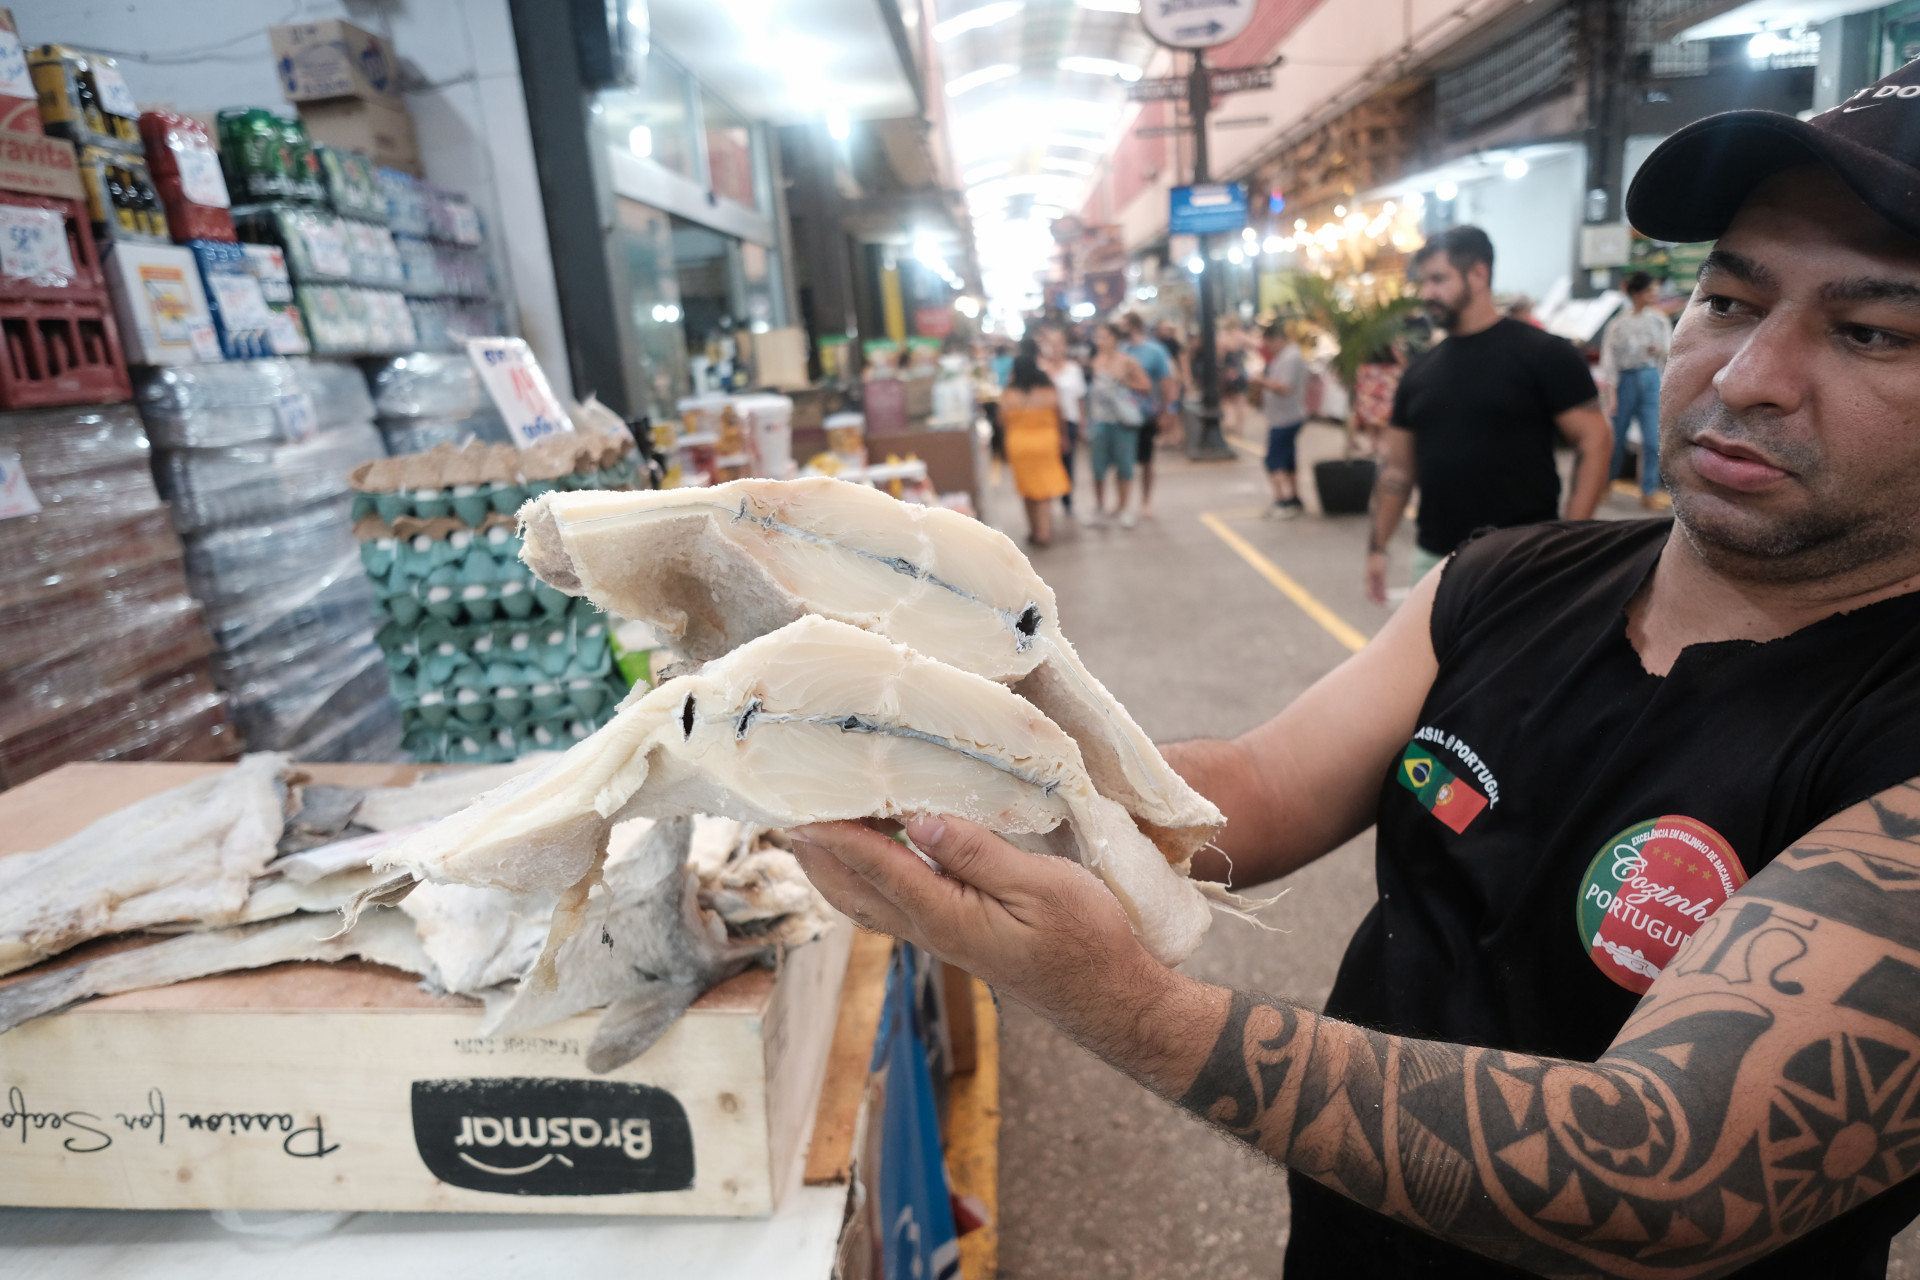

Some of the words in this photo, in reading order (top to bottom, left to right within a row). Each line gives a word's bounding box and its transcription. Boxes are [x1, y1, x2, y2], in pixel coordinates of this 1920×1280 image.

[1452, 739, 1499, 810] PORTUGAL
[1669, 830, 1680, 839] EM
[1678, 831, 1709, 854] BOLINHO
[1706, 851, 1715, 863] DE
[1611, 844, 1713, 922] Cozinh
[115, 1086, 164, 1144] for
[179, 1113, 341, 1157] Passion
[455, 1116, 652, 1160] Brasmar
